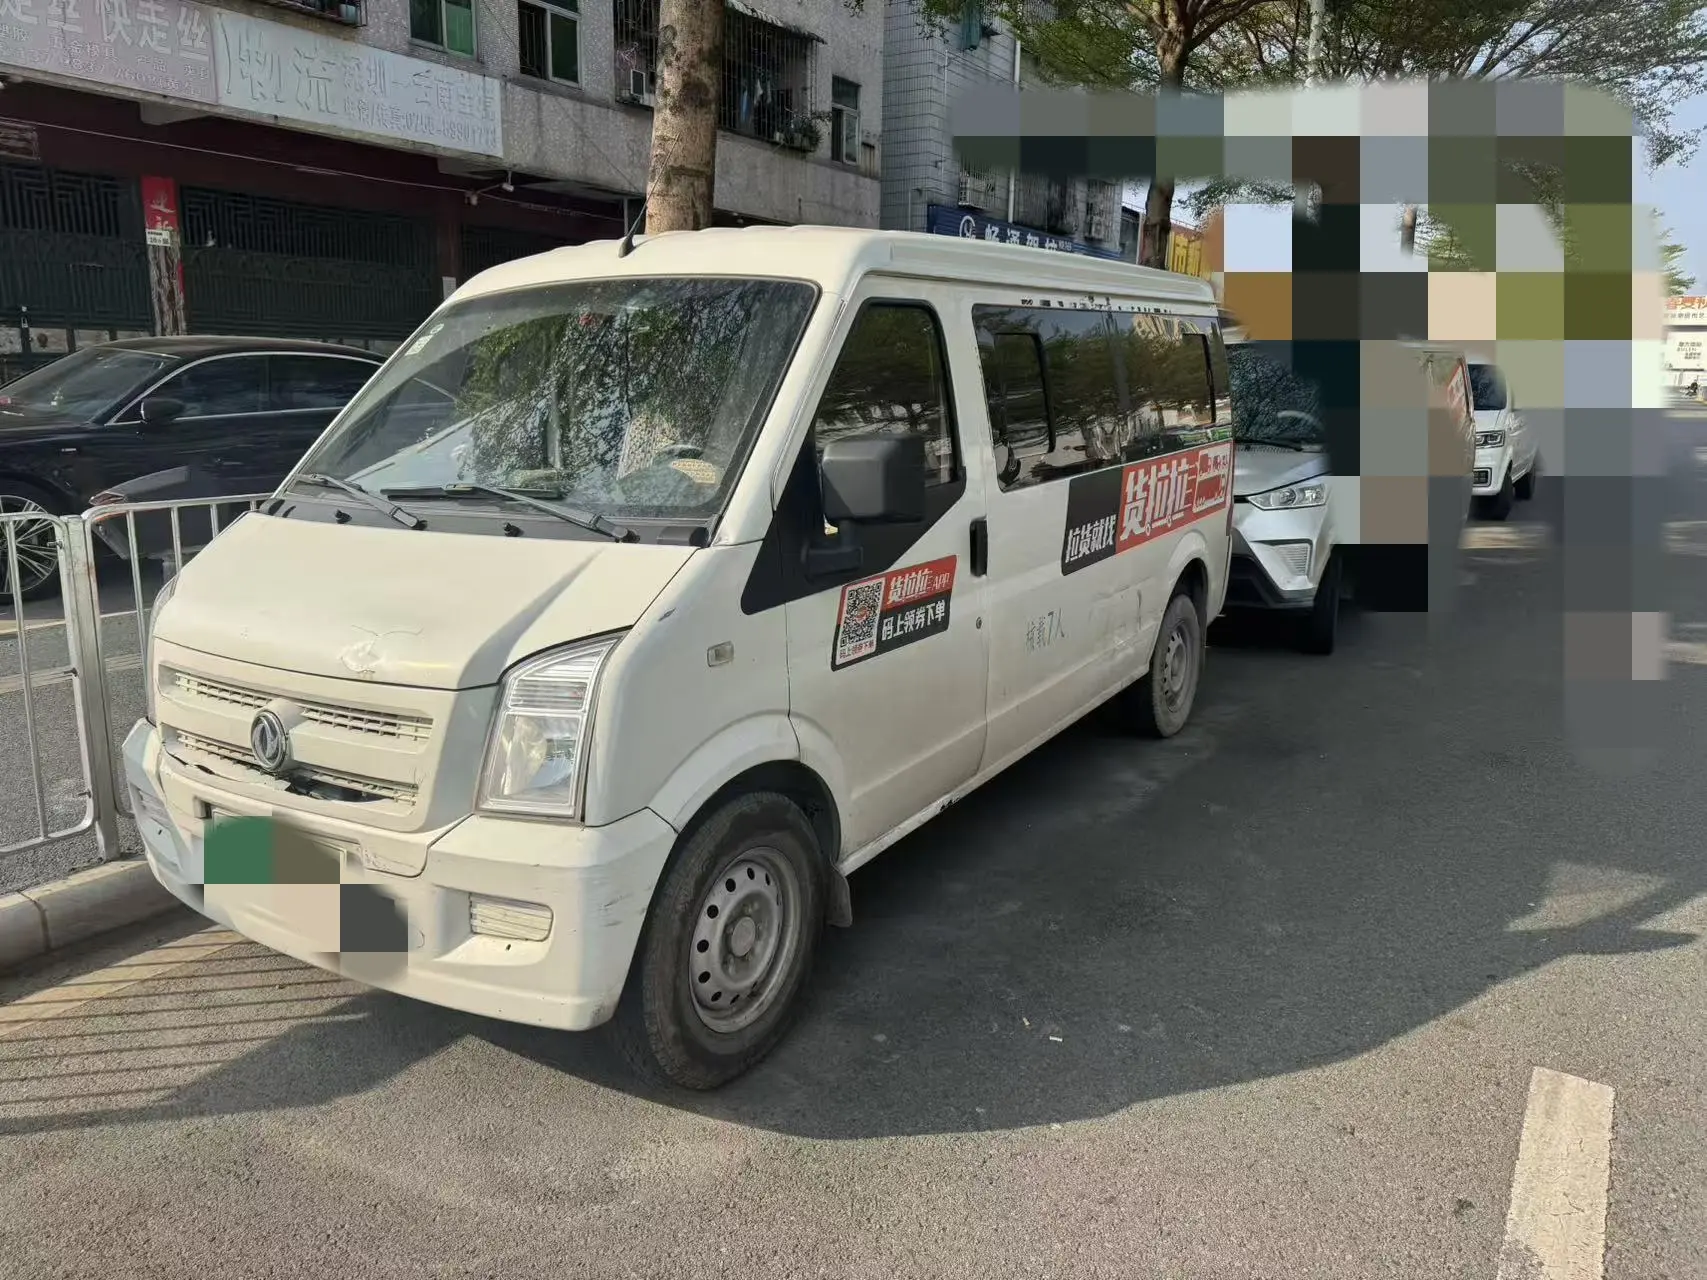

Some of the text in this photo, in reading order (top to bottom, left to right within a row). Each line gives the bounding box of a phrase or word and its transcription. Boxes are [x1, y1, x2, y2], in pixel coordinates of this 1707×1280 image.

[238, 26, 338, 114] 物流
[1065, 514, 1117, 562] 拉货就找
[881, 599, 946, 641] 码上领券下单
